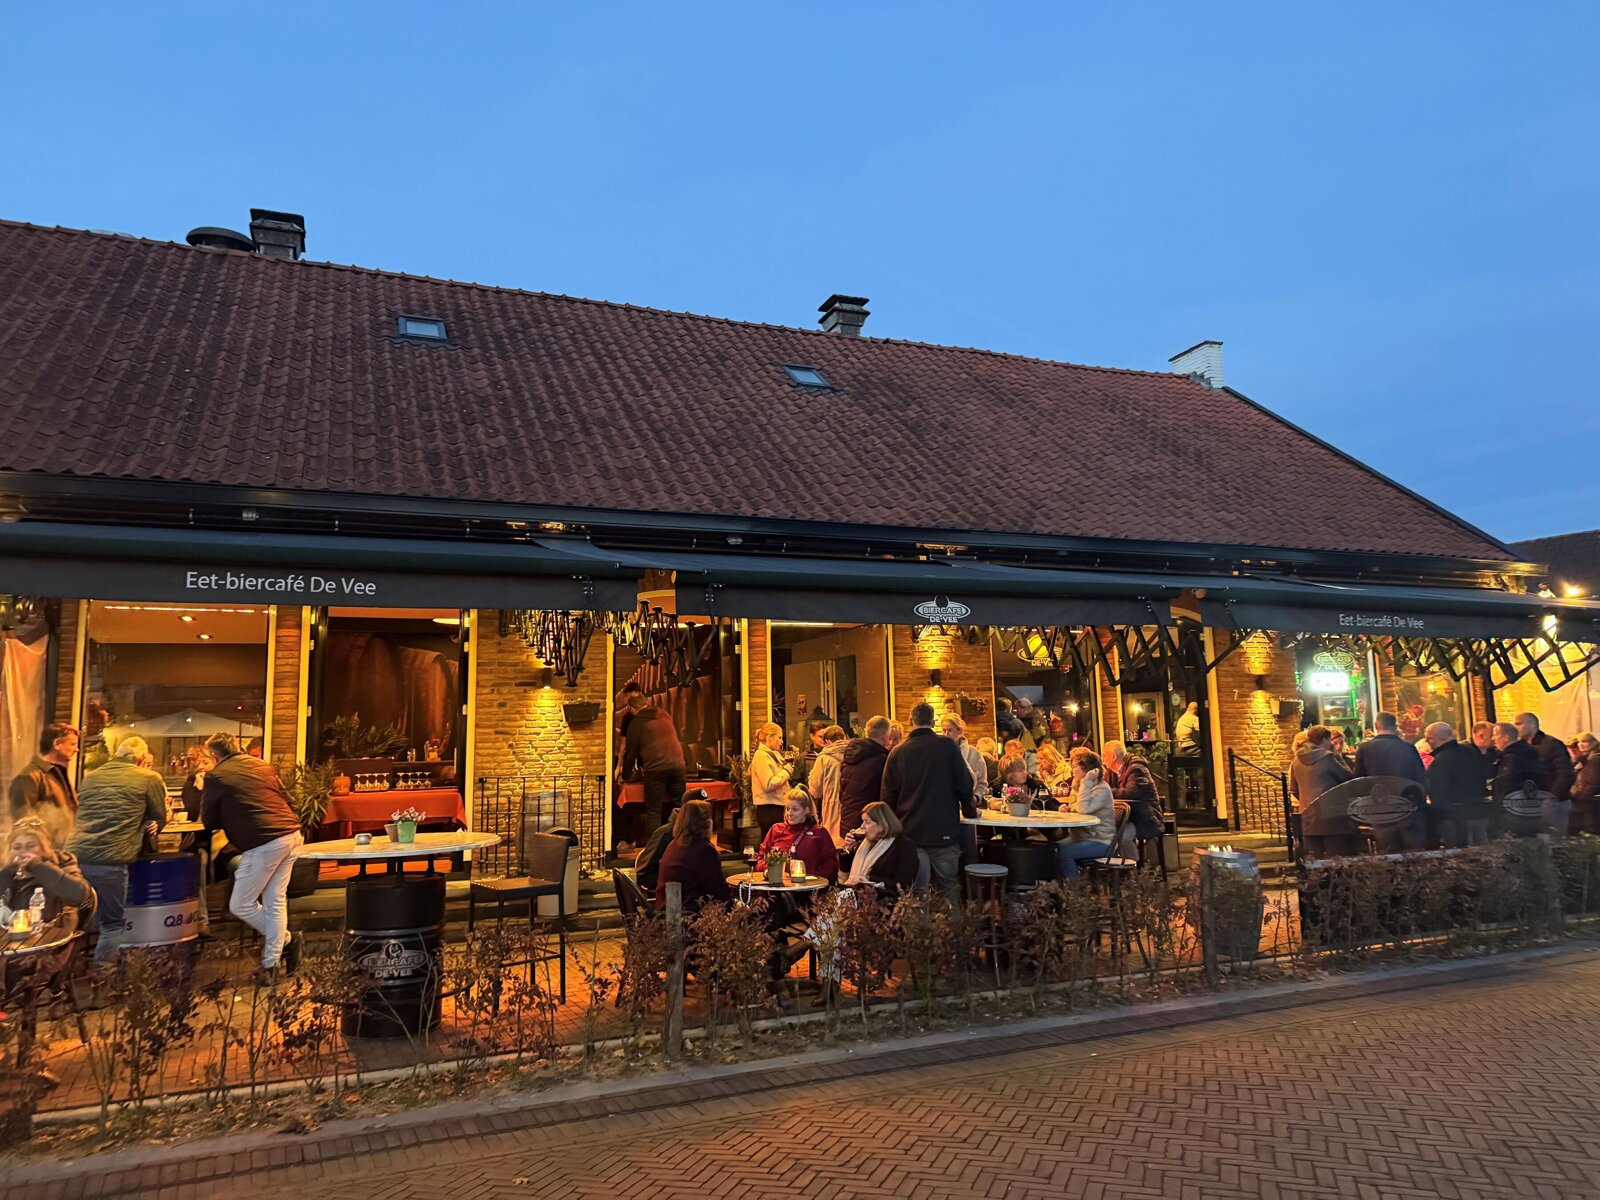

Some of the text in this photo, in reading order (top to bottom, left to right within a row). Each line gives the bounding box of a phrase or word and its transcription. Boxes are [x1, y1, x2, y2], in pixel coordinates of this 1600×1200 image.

[186, 571, 377, 595] Eet-biercafé De Vee
[1339, 613, 1425, 629] Eet-biercafé De Vee
[164, 914, 184, 927] Q8
